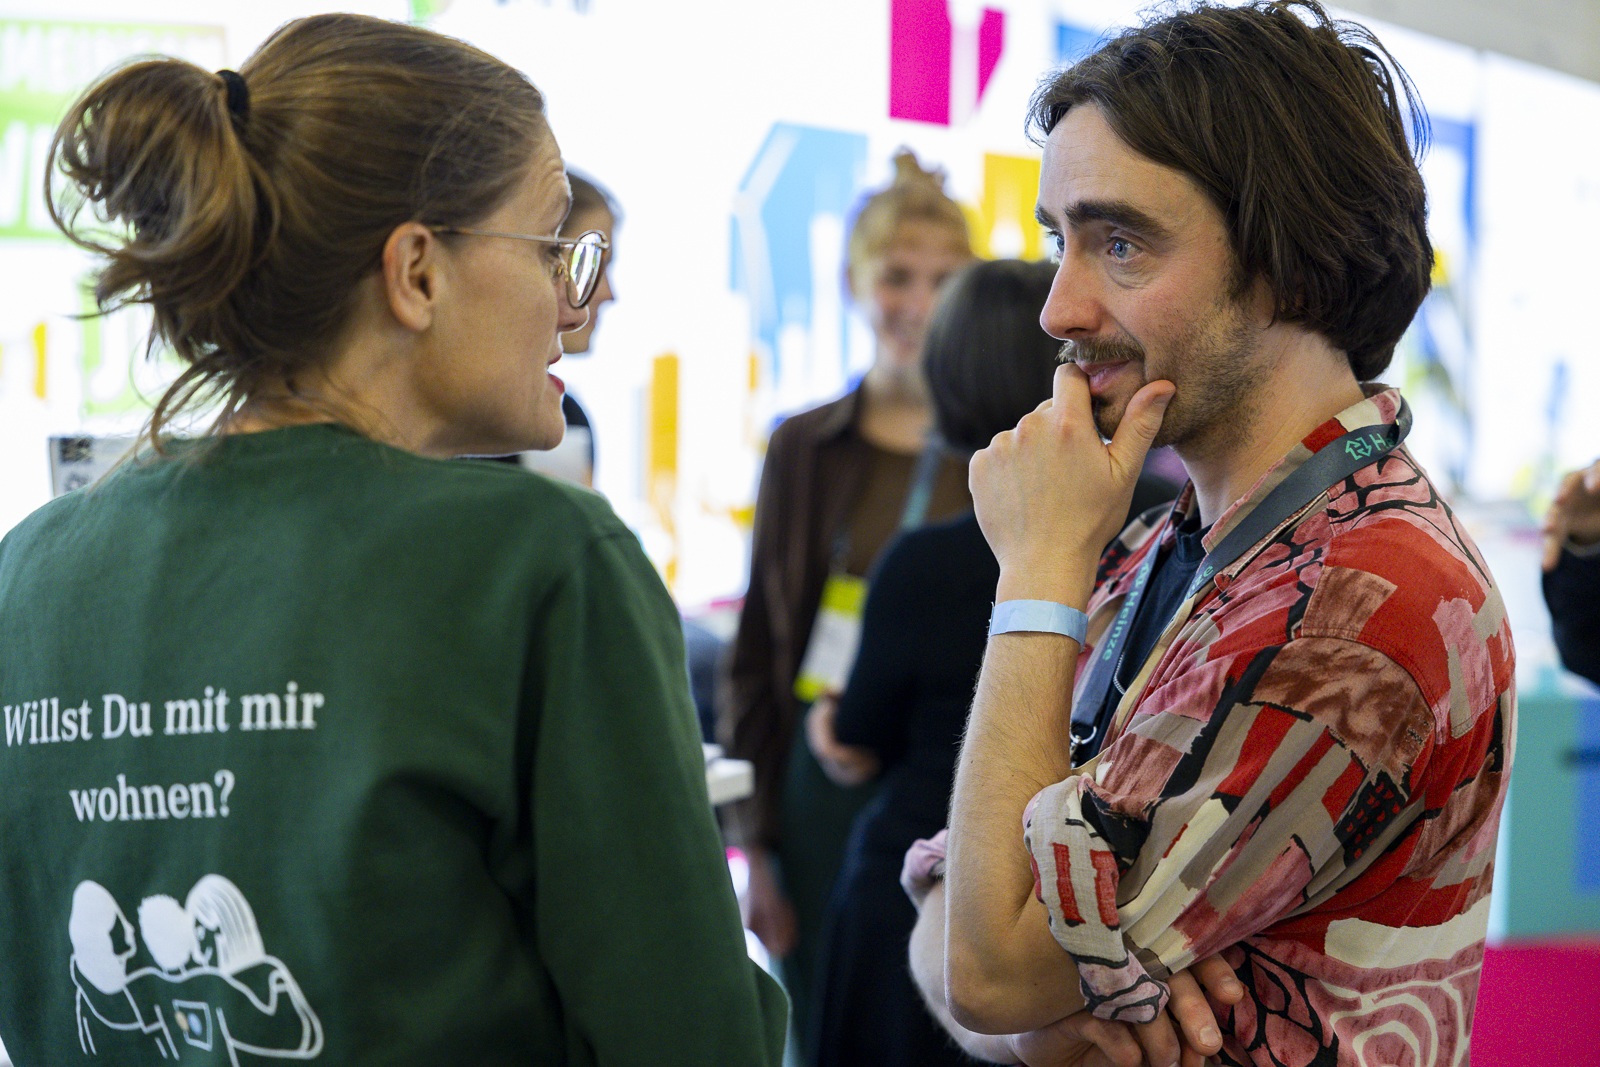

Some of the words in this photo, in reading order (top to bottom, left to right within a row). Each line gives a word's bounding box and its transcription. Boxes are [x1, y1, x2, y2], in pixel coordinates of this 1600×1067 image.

[1102, 591, 1139, 661] Heinze
[3, 697, 93, 748] Willst
[101, 693, 154, 739] Du
[163, 685, 231, 735] mit
[239, 680, 325, 731] mir
[68, 768, 236, 822] wohnen?
